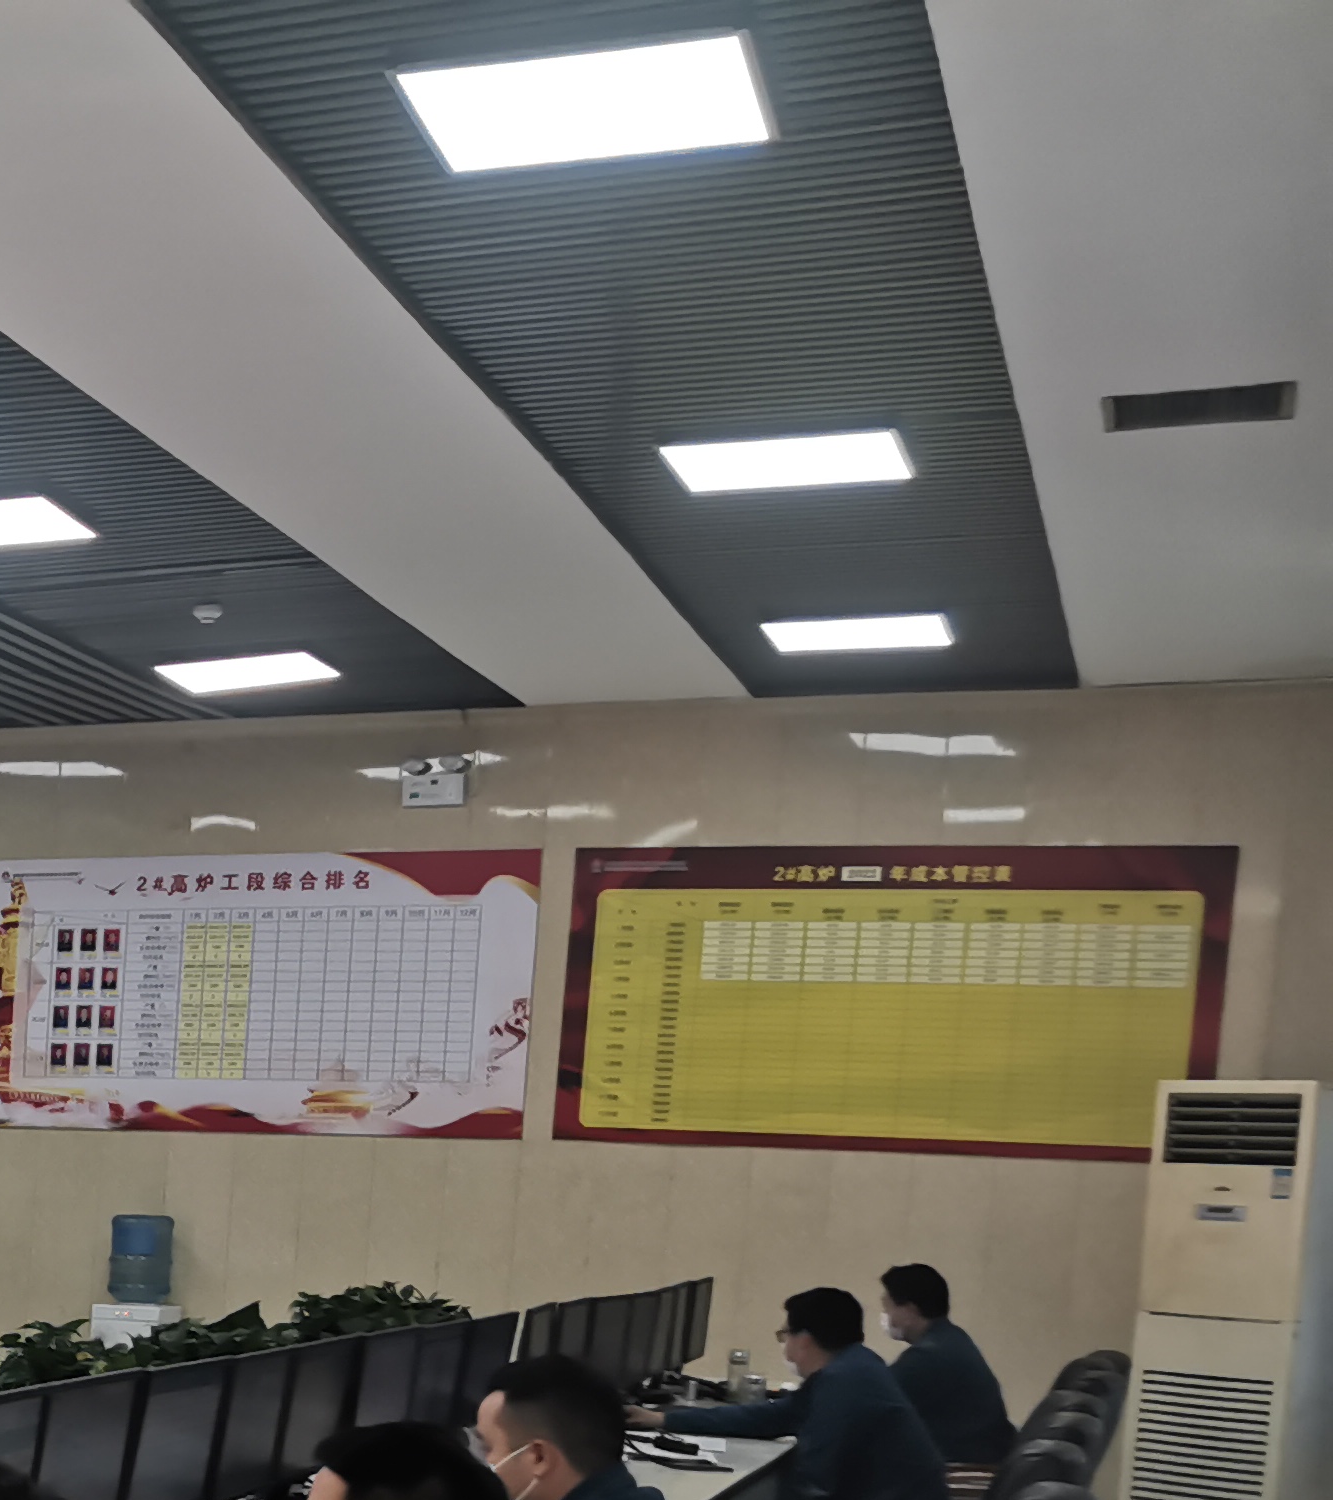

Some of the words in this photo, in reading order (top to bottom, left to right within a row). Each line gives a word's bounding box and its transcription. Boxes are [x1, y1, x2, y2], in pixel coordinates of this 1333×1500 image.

[135, 869, 372, 897] 2#高炉工段综合排名
